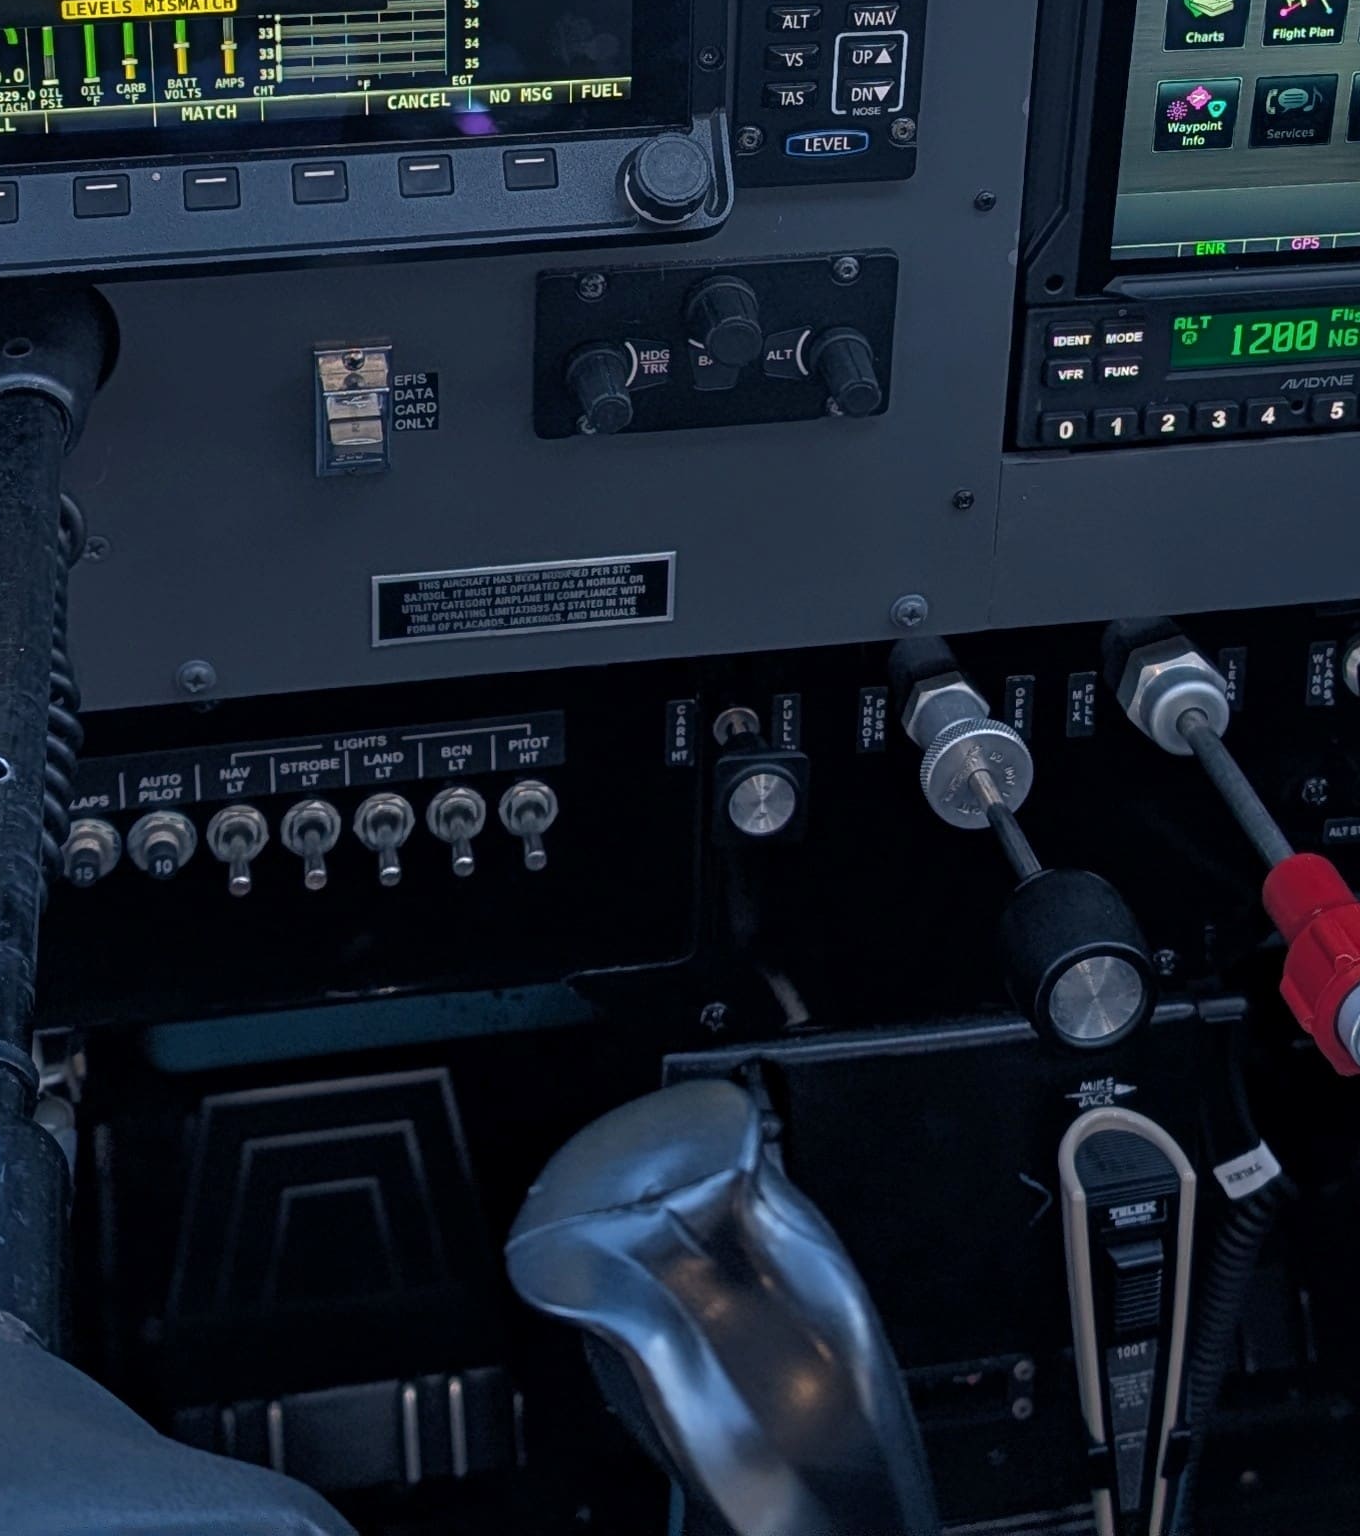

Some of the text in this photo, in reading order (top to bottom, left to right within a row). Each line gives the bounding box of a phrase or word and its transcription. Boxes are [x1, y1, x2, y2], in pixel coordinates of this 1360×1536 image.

[782, 15, 810, 29] ALT
[854, 11, 896, 26] VNAV
[1185, 29, 1225, 44] Charts
[1272, 24, 1334, 41] Flight Plan
[785, 53, 803, 67] VS
[852, 49, 873, 64] UP
[489, 86, 553, 104] NO MSG
[581, 83, 623, 99] FUEL
[851, 87, 873, 101] DN
[387, 93, 451, 111] CANCEL
[181, 104, 238, 122] MATCH
[1167, 119, 1223, 135] Waypoint
[804, 137, 851, 152] LEVEL
[1182, 133, 1206, 147] Info
[1196, 241, 1226, 256] ENR
[1291, 236, 1320, 251] GPS
[1053, 333, 1091, 347] IDENT
[1106, 331, 1143, 345] MODE
[1230, 319, 1319, 356] 1200
[640, 349, 670, 361] HDG
[766, 348, 793, 361] ALT
[1058, 367, 1084, 381] VFR
[1104, 364, 1139, 379] FUNC
[1280, 374, 1355, 390] AVIDYNE
[393, 387, 434, 401] DATA
[394, 401, 437, 416] CARD
[334, 735, 388, 750] LIGHTS
[508, 736, 549, 752] PITOT
[363, 750, 404, 765] LAND
[279, 758, 341, 775] STROBE
